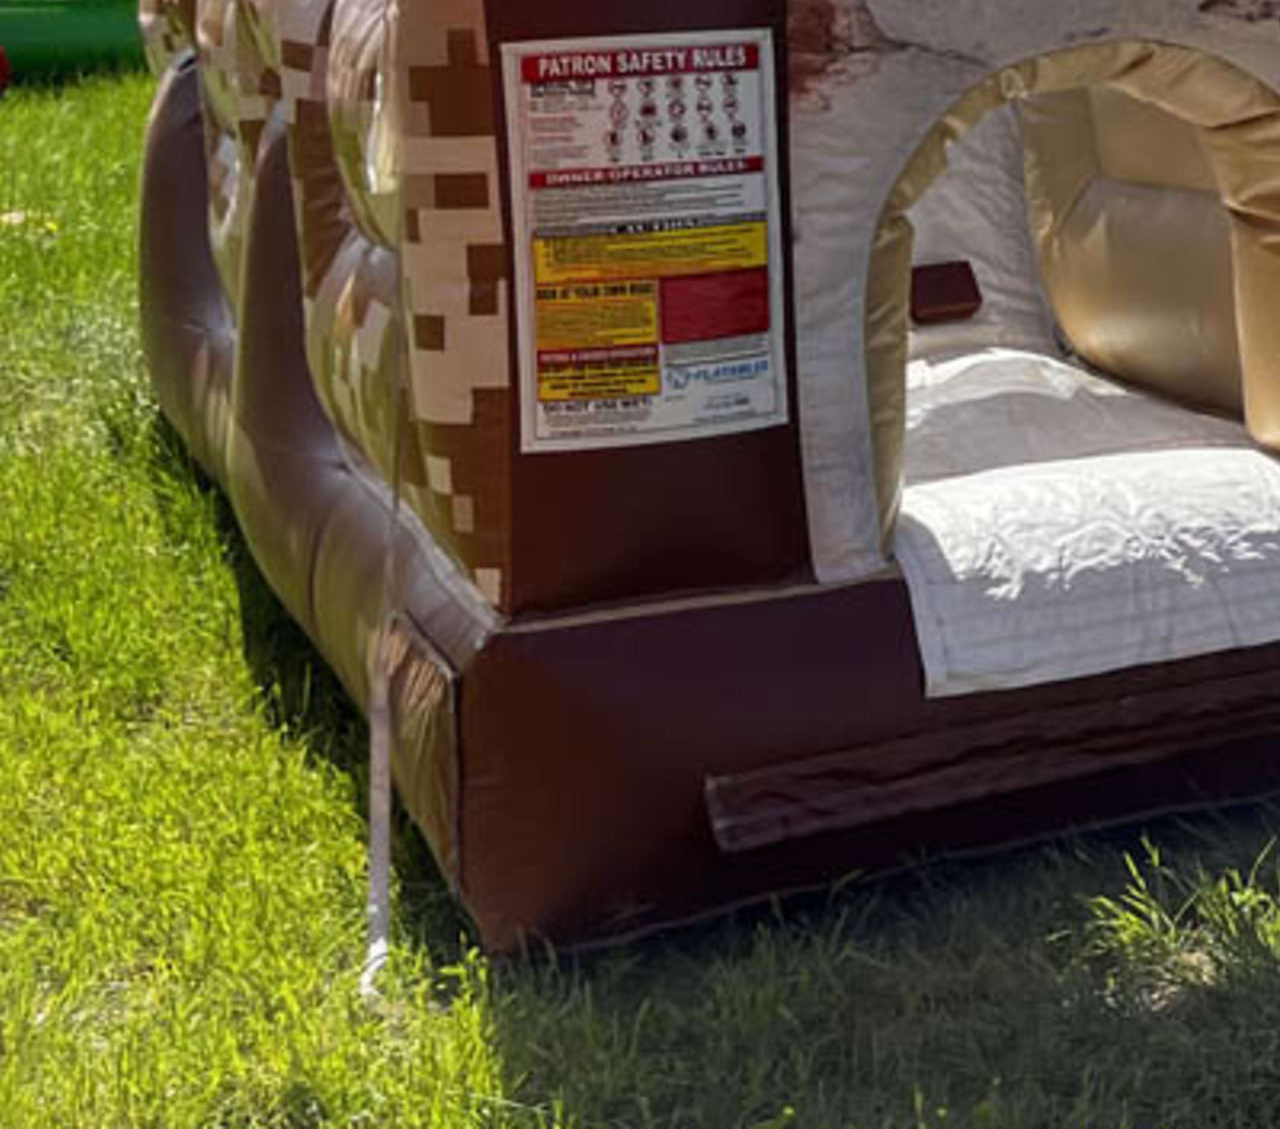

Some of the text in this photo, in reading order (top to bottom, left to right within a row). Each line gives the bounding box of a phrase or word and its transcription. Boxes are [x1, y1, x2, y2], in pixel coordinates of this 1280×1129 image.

[538, 46, 747, 77] PATRON SAFETY RULES
